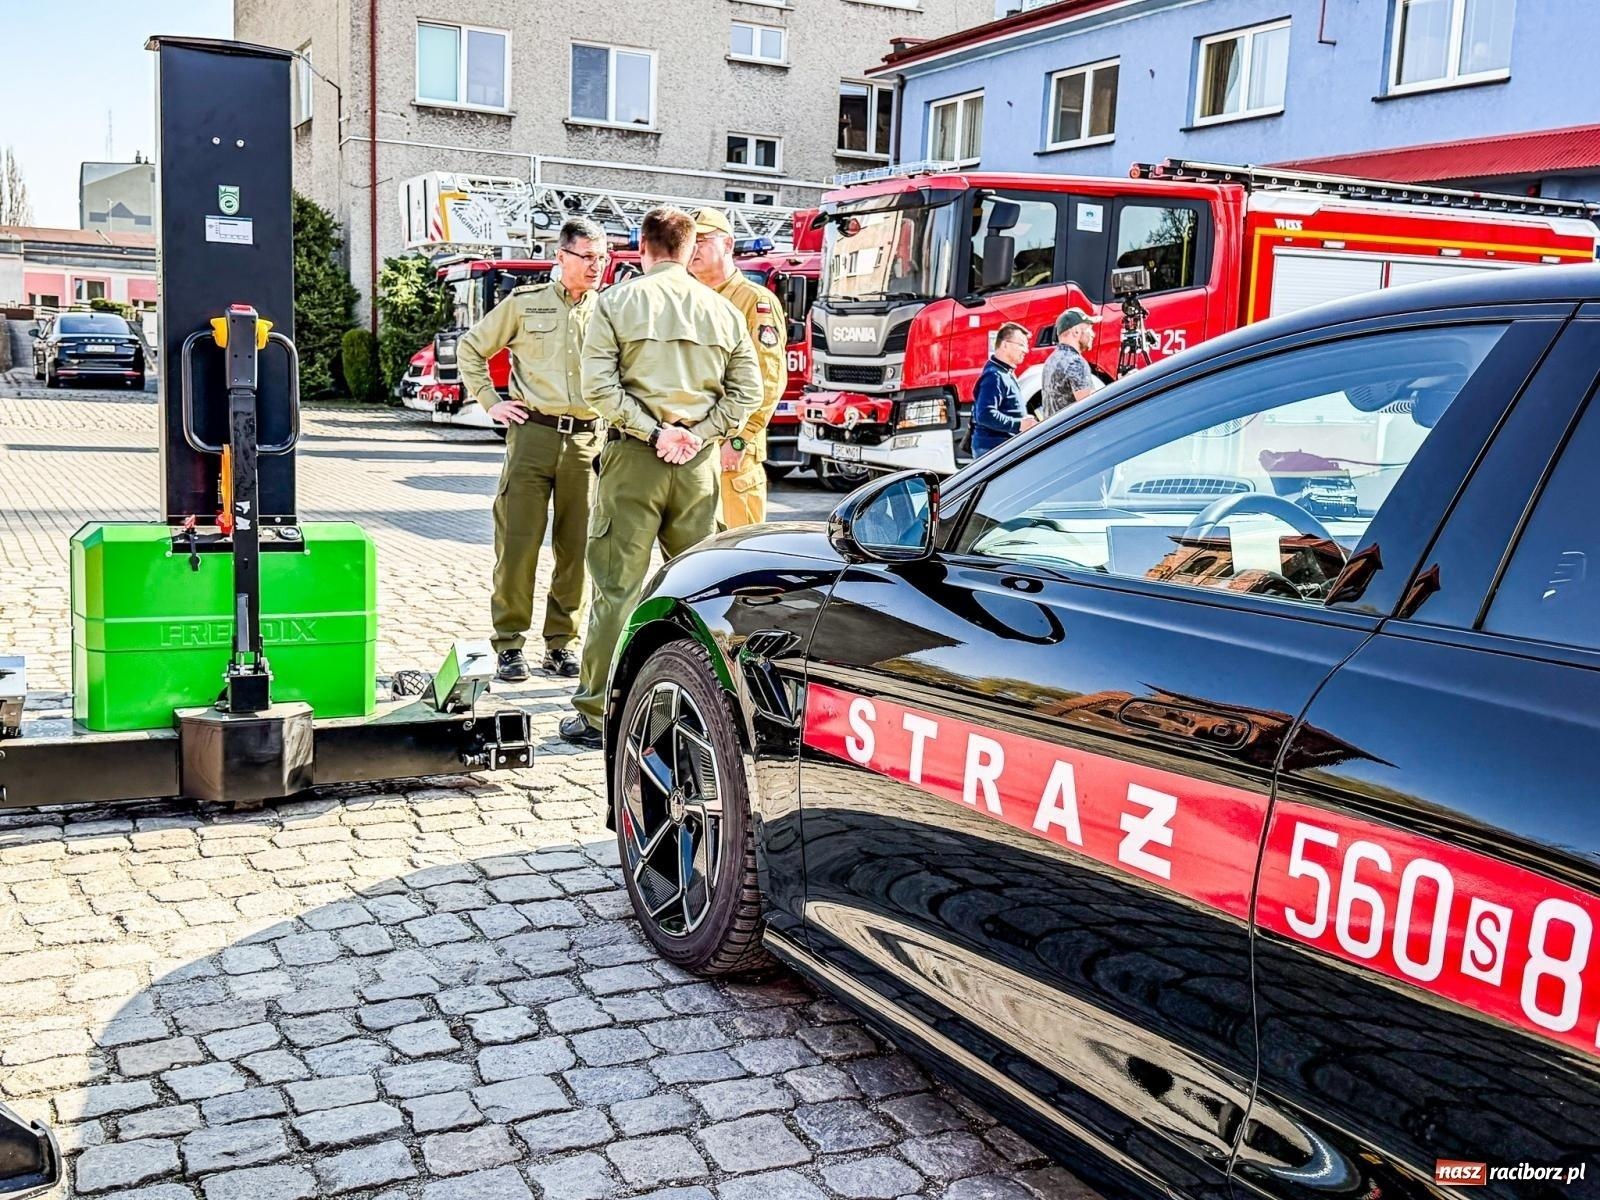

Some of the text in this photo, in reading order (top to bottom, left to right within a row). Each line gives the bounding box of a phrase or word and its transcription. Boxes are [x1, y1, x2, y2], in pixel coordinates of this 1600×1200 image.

[452, 206, 481, 239] MAGIRUS
[832, 326, 877, 343] SCANIA
[1161, 329, 1187, 355] 25
[160, 619, 317, 647] FREDIX
[1284, 821, 1455, 982] 560
[1520, 898, 1600, 1048] 8
